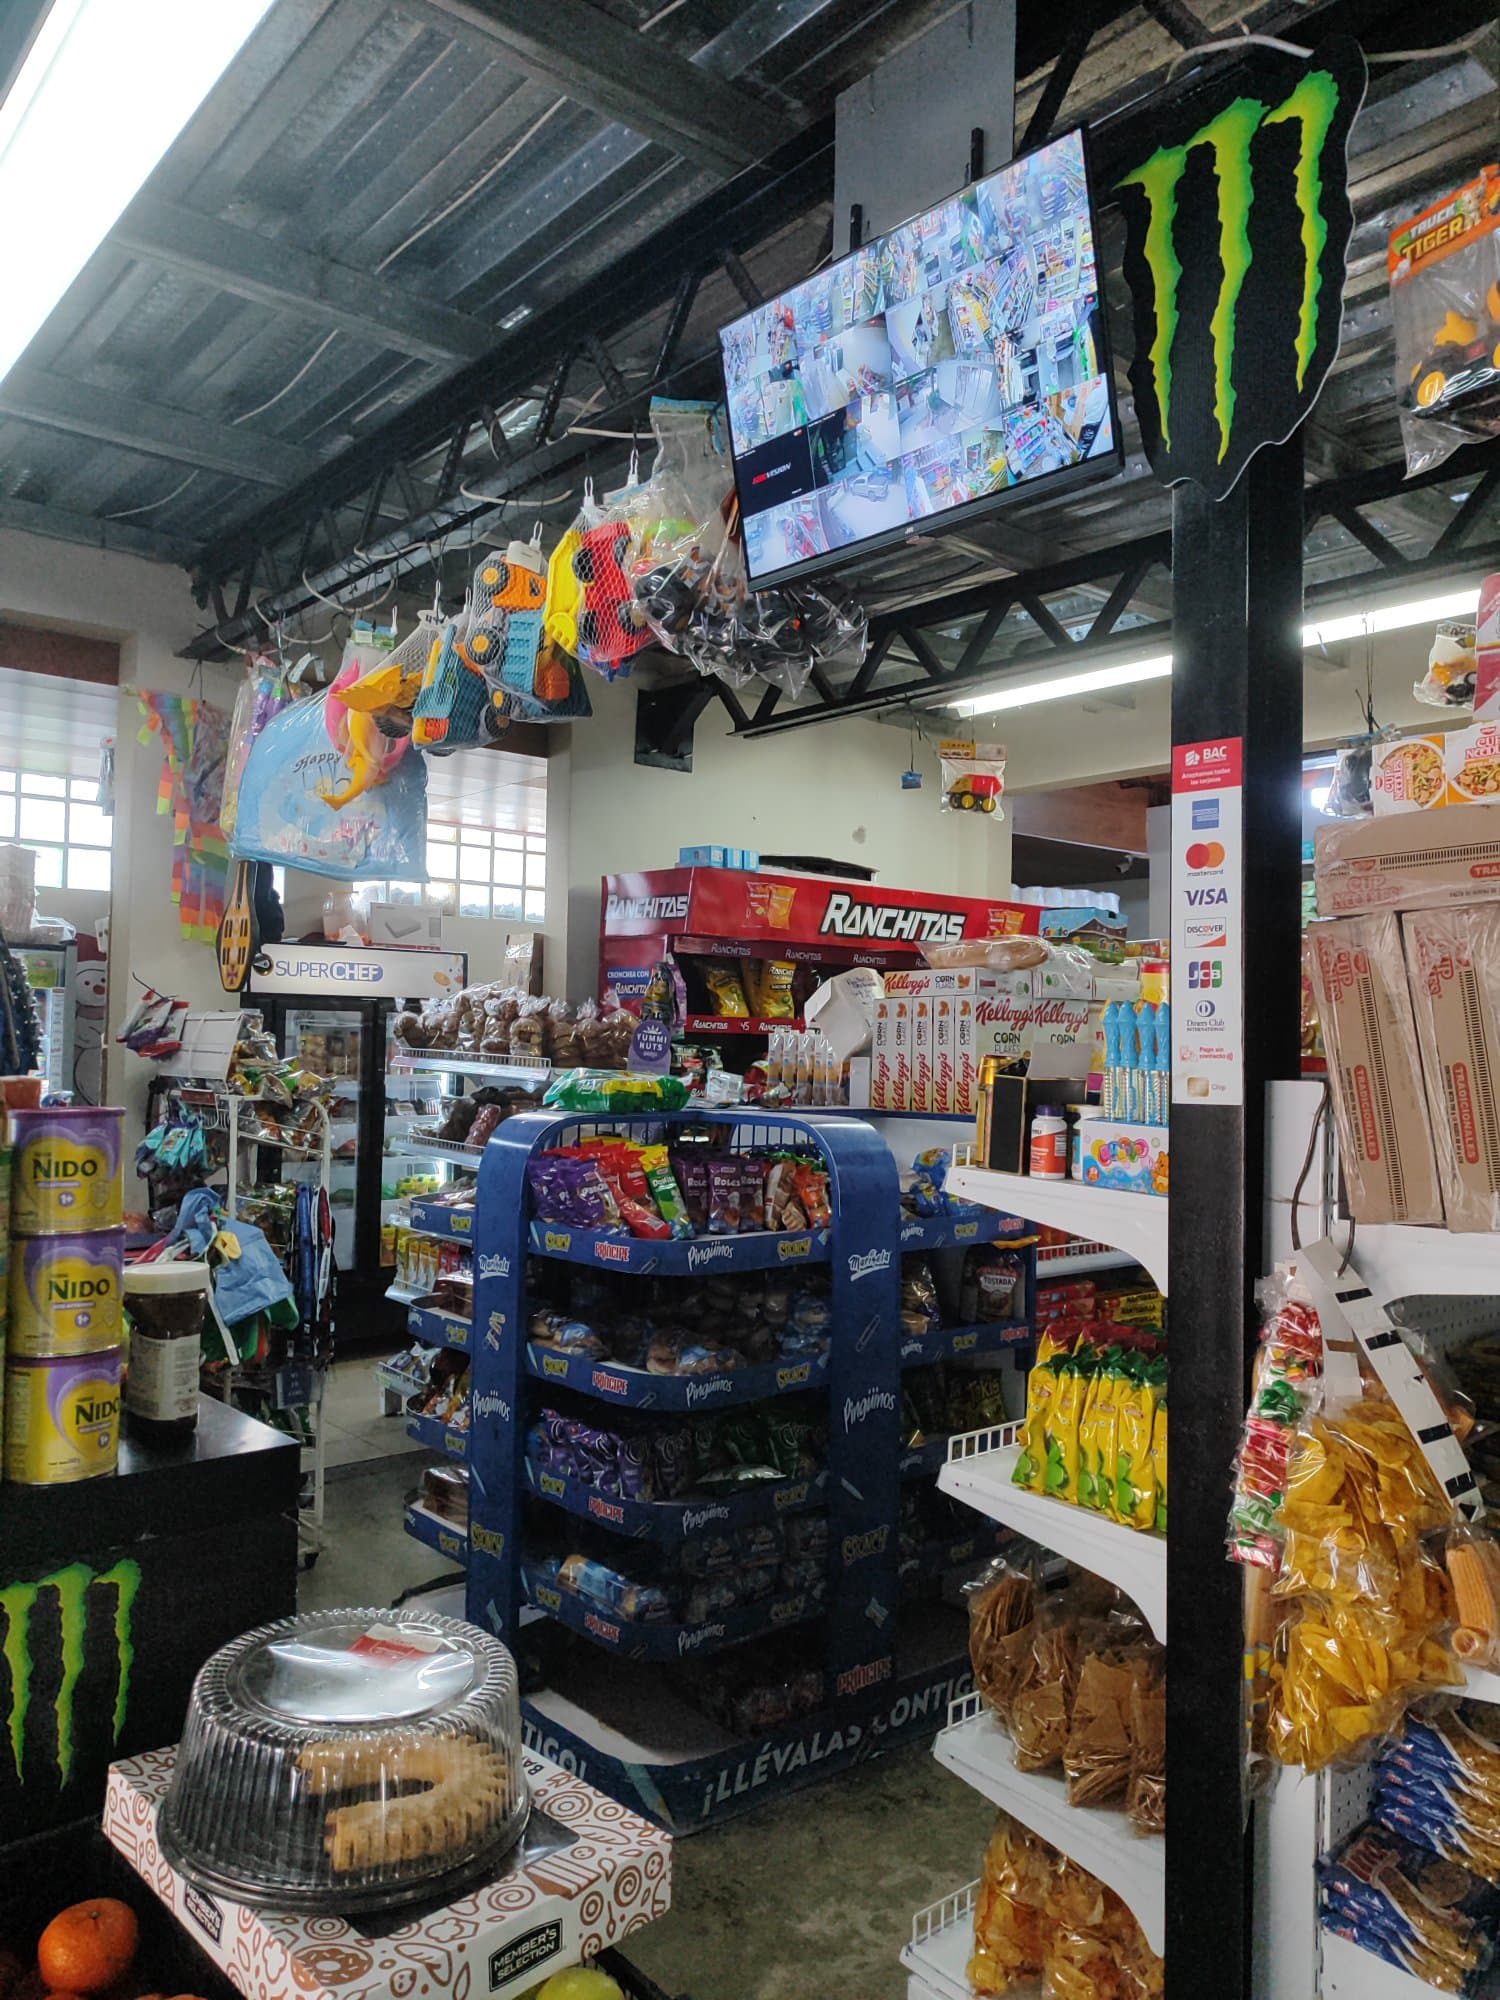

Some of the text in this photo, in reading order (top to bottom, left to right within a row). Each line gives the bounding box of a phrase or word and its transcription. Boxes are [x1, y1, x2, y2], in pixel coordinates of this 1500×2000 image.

[1410, 202, 1457, 238] TRUCK
[1401, 214, 1465, 261] TIGER
[293, 752, 342, 773] Happy
[1203, 746, 1227, 759] BAC
[605, 894, 690, 920] RANCHITAS
[1184, 888, 1228, 906] VISA
[820, 892, 967, 943] RANCHITAS
[1187, 925, 1223, 934] DISCOVER
[884, 973, 931, 995] Kellogg's
[935, 975, 955, 983] CORN
[976, 997, 1033, 1031] Kellogg's
[1034, 999, 1088, 1032] Kellogg's
[1187, 1018, 1224, 1027] Diners Club
[637, 1032, 668, 1044] YUMMI
[640, 1041, 663, 1051] NUTS
[994, 1032, 1021, 1044] CORN
[872, 1052, 890, 1109] Kellogg's
[892, 1051, 909, 1111] Kellogg's
[914, 1052, 931, 1112] Kellogg's
[935, 1052, 953, 1113] Kellogg's
[957, 1051, 975, 1115] Kellogg's
[1355, 1068, 1379, 1159] TRADICIONALES
[1454, 1066, 1478, 1161] TRADICIONALES
[32, 1158, 98, 1180] NIDO
[687, 1177, 707, 1187] Role
[687, 1241, 734, 1271] Pingüinos
[48, 1278, 110, 1301] NIDO
[473, 1389, 511, 1423] Pingüinos
[686, 1374, 733, 1407] Pingüinos
[843, 1387, 895, 1434] Pingüinos
[682, 1503, 730, 1536] Pingüinos
[677, 1621, 727, 1656] Pingüinos
[494, 1927, 558, 1972] MEMBER'S
[496, 1941, 556, 1981] SELECTION
